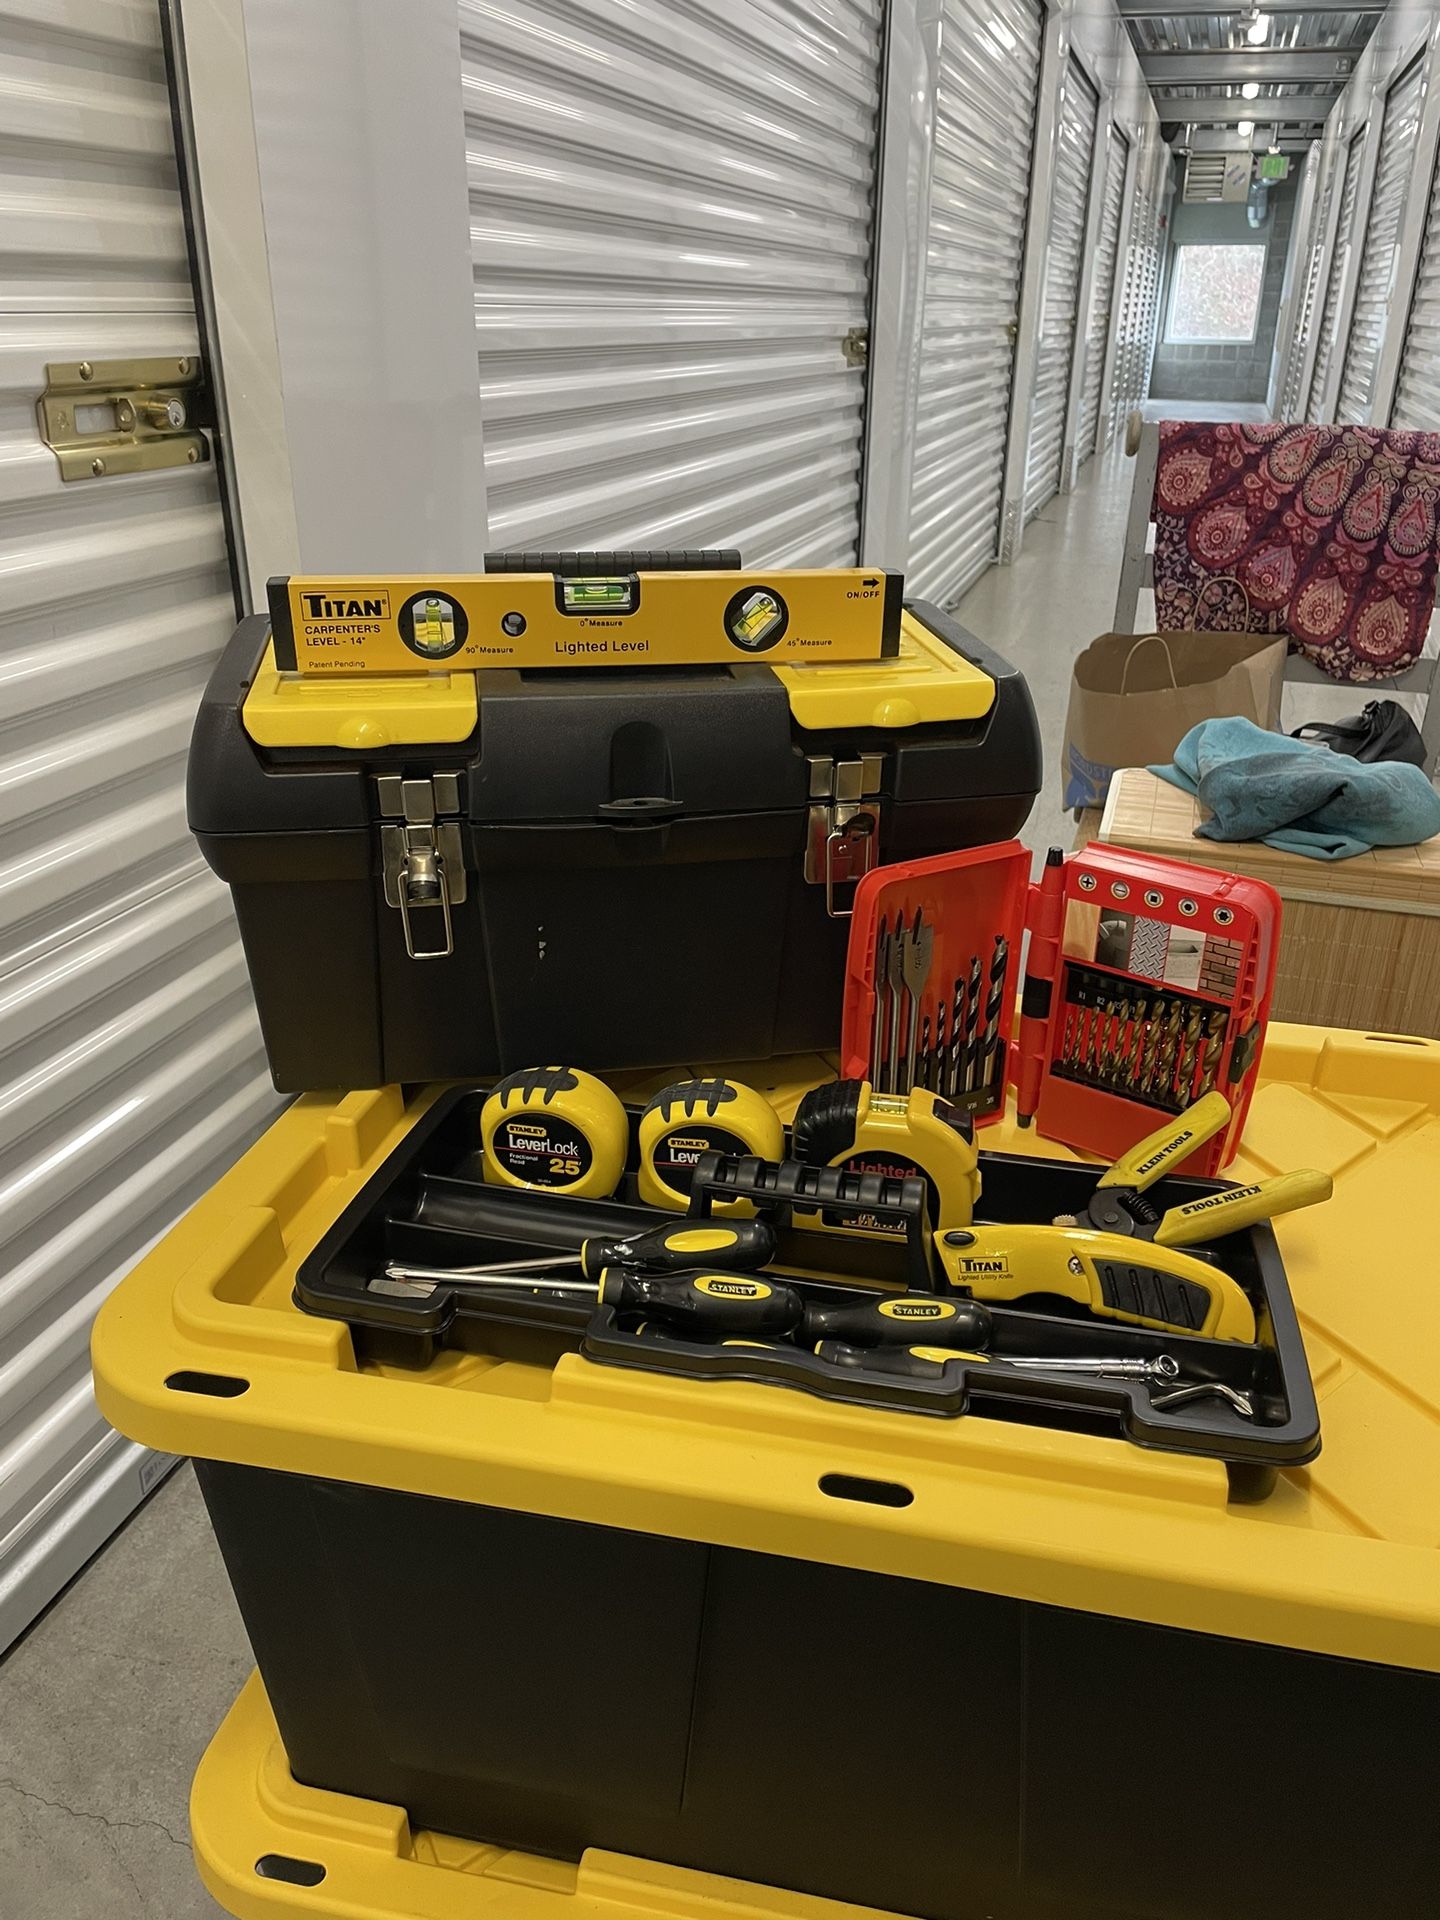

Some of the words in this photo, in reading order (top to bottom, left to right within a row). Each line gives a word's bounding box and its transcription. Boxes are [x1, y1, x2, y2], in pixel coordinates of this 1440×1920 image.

[846, 590, 880, 599] ON/OFF
[304, 624, 381, 635] CARPENTER'S
[306, 637, 341, 647] LEVEL
[350, 636, 366, 645] 14"
[554, 640, 608, 655] Lighted
[612, 640, 649, 652] Level
[308, 661, 333, 669] Patent
[334, 660, 366, 669] Pending
[509, 1125, 545, 1136] STANLEY
[508, 1133, 579, 1156] LeverLock
[670, 1139, 707, 1147] STANLEY
[1136, 1151, 1168, 1175] KLEIN
[1162, 1130, 1193, 1155] TOOLS
[1224, 1185, 1263, 1203] KLEIN
[1181, 1198, 1223, 1216] TOOLS
[961, 1259, 1003, 1272] TITAN
[957, 1274, 980, 1282] Lighted
[710, 1282, 756, 1295] STANLEY
[895, 1307, 938, 1316] STANLEY
